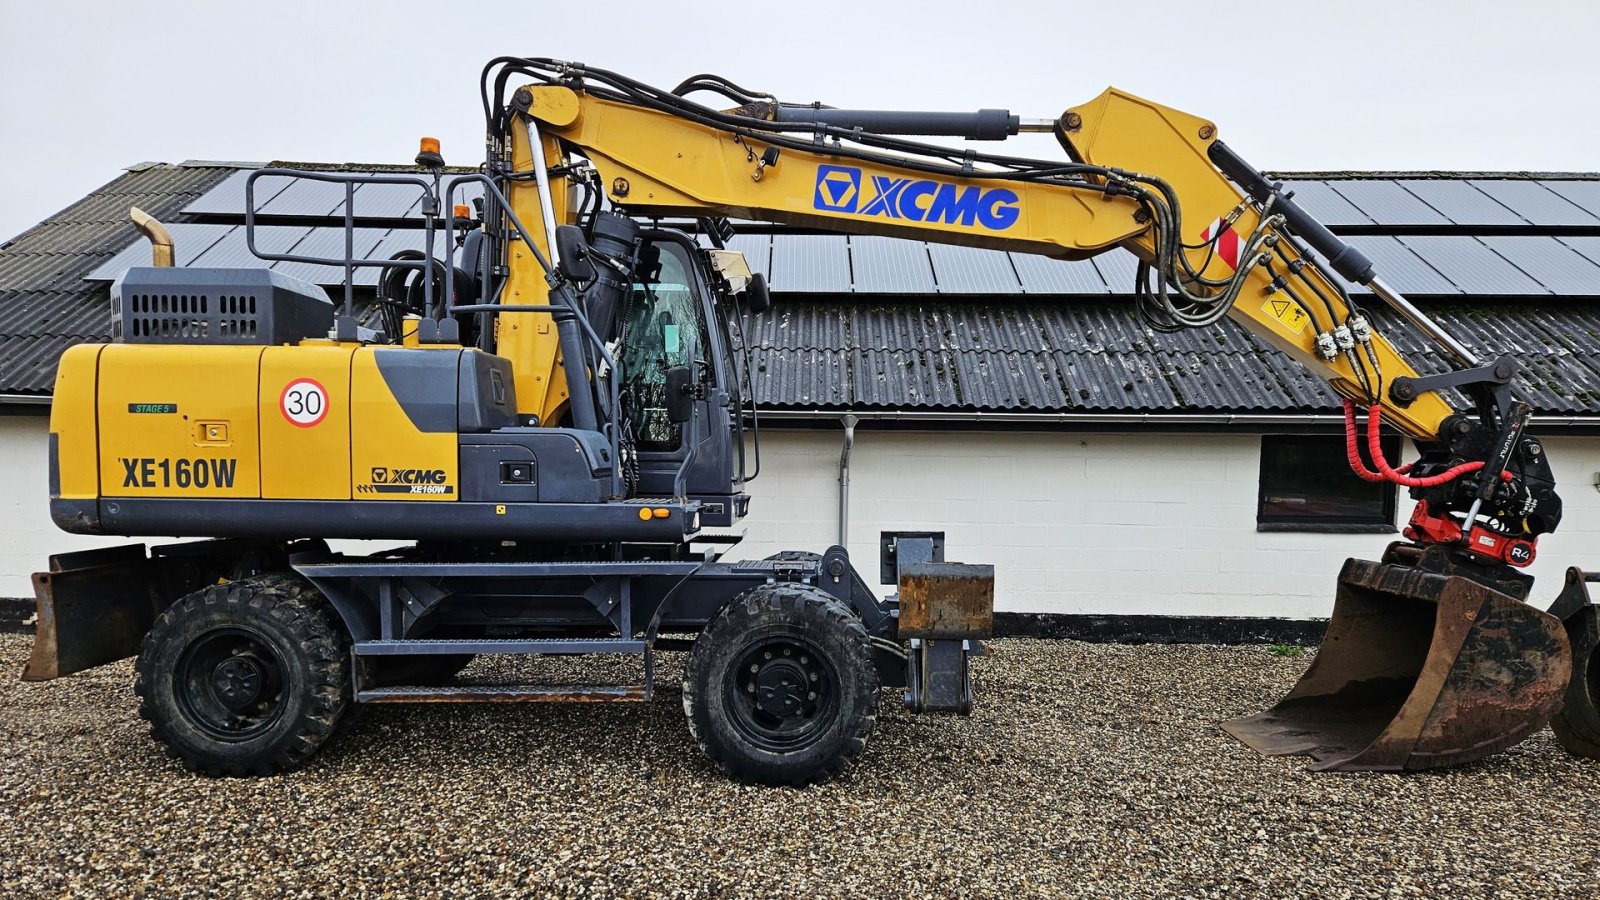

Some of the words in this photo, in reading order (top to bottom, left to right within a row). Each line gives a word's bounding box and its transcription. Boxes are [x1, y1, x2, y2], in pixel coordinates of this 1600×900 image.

[857, 175, 1020, 230] XCMG
[136, 404, 162, 413] STAGE
[163, 404, 170, 413] 5
[287, 390, 321, 415] 30
[122, 458, 237, 488] XE160W
[389, 469, 446, 484] XCMG
[410, 485, 447, 494] XE160W
[1511, 547, 1530, 560] R4
